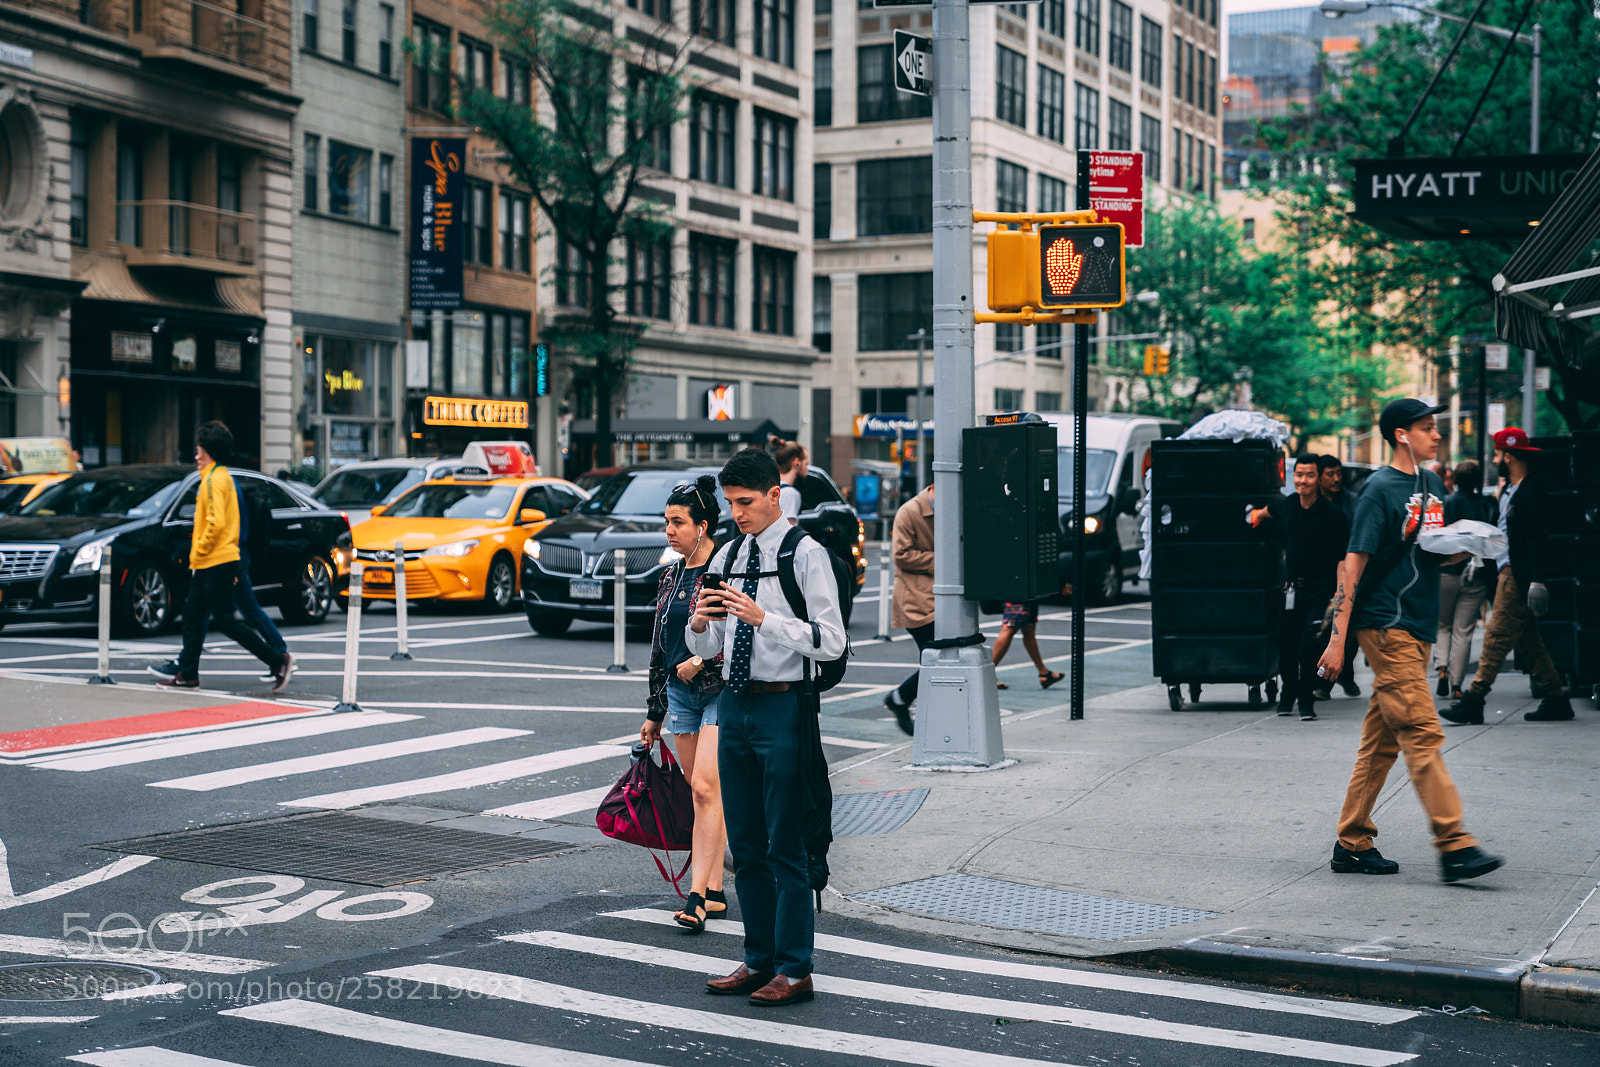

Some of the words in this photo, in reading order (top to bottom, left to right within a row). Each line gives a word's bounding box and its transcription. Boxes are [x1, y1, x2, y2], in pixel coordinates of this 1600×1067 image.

[904, 50, 923, 76] ONE
[425, 140, 460, 197] Spa
[1089, 166, 1115, 178] nytime
[1095, 155, 1134, 166] STANDING
[1372, 171, 1482, 198] HYATT
[1094, 201, 1133, 212] STANDING
[434, 202, 453, 252] Blue
[431, 401, 473, 421] THINK
[476, 403, 523, 424] COFFEE
